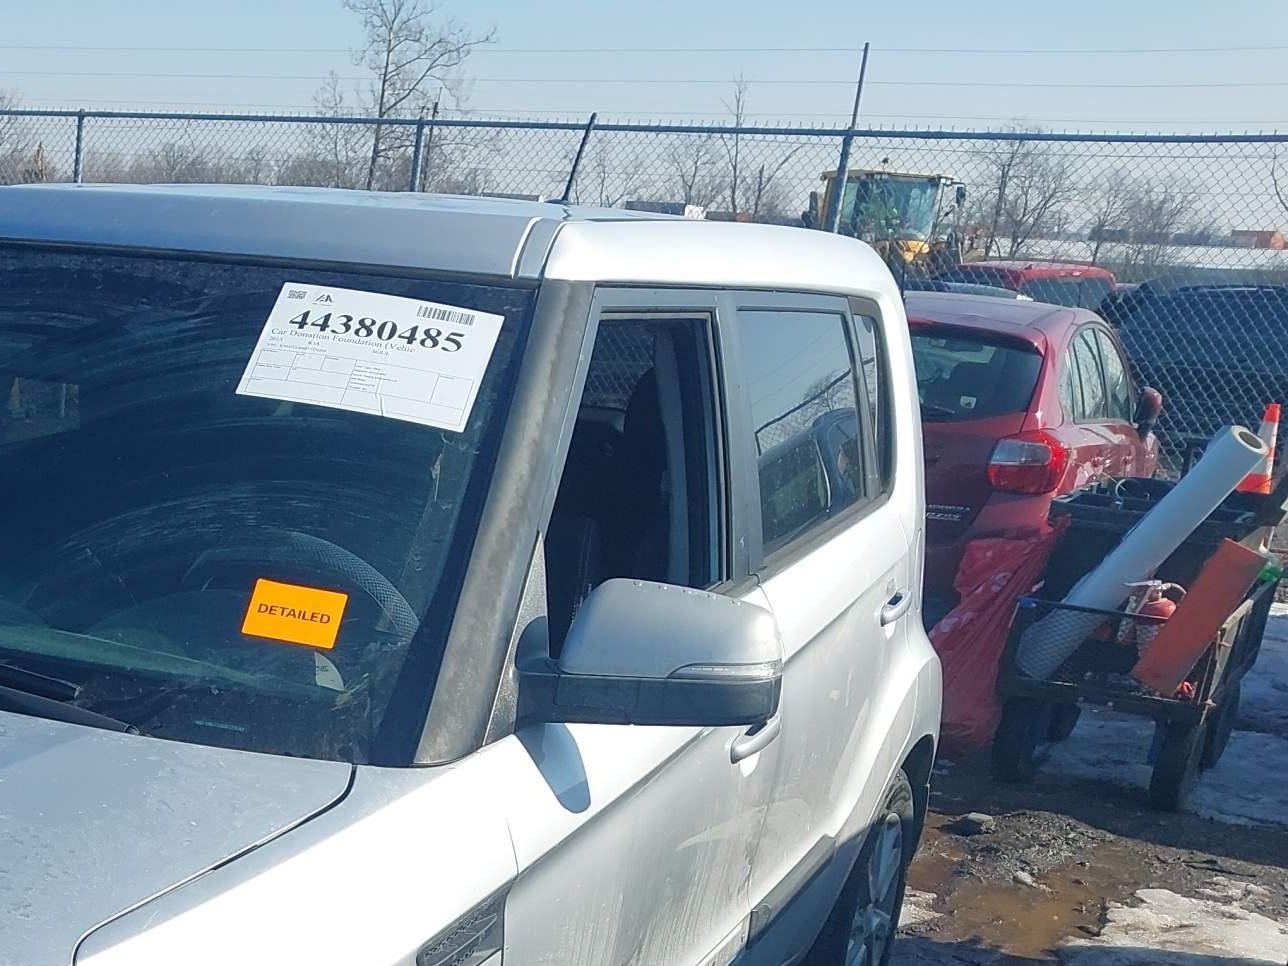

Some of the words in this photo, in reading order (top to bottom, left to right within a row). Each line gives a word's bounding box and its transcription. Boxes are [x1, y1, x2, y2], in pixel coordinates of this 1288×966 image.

[271, 327, 288, 336] Car
[289, 330, 330, 340] Donation
[332, 334, 382, 348] Foundation
[289, 310, 465, 353] 44380485
[257, 603, 331, 624] DETAILED
